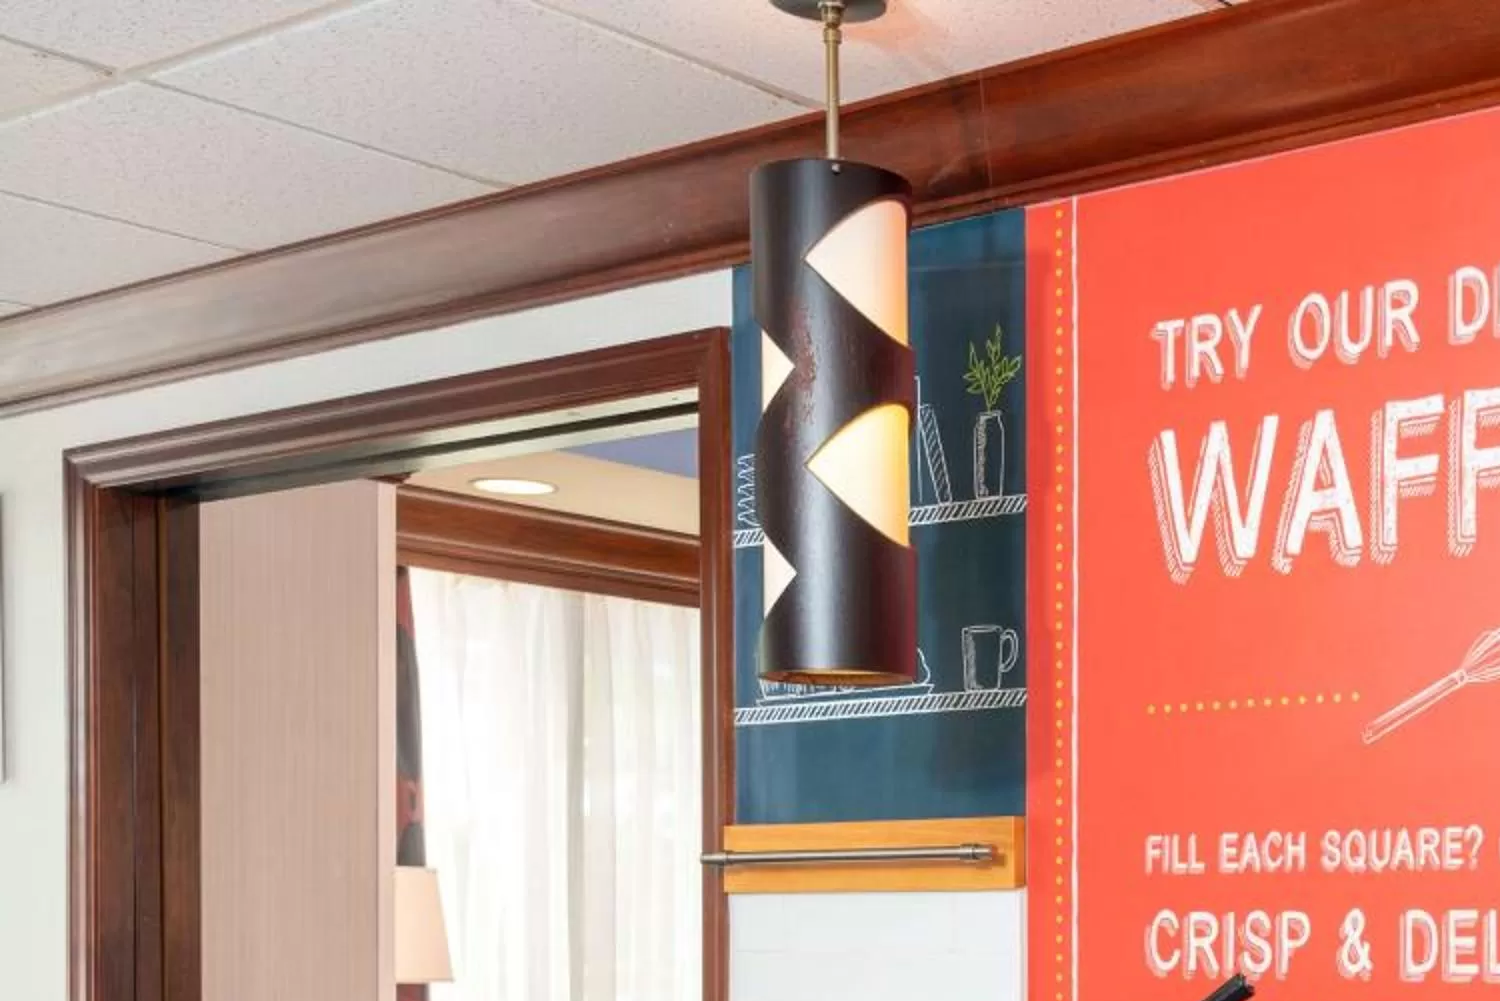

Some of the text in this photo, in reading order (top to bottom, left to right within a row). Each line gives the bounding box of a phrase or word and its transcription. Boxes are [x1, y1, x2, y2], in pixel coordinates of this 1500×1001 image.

[1150, 304, 1262, 390] TRY
[1288, 279, 1420, 371] OUR
[1145, 834, 1205, 874] FILL
[1219, 830, 1306, 873] EACH
[1321, 825, 1483, 872] SQUARE?
[1145, 908, 1311, 981] CRISP
[1336, 907, 1373, 981] &
